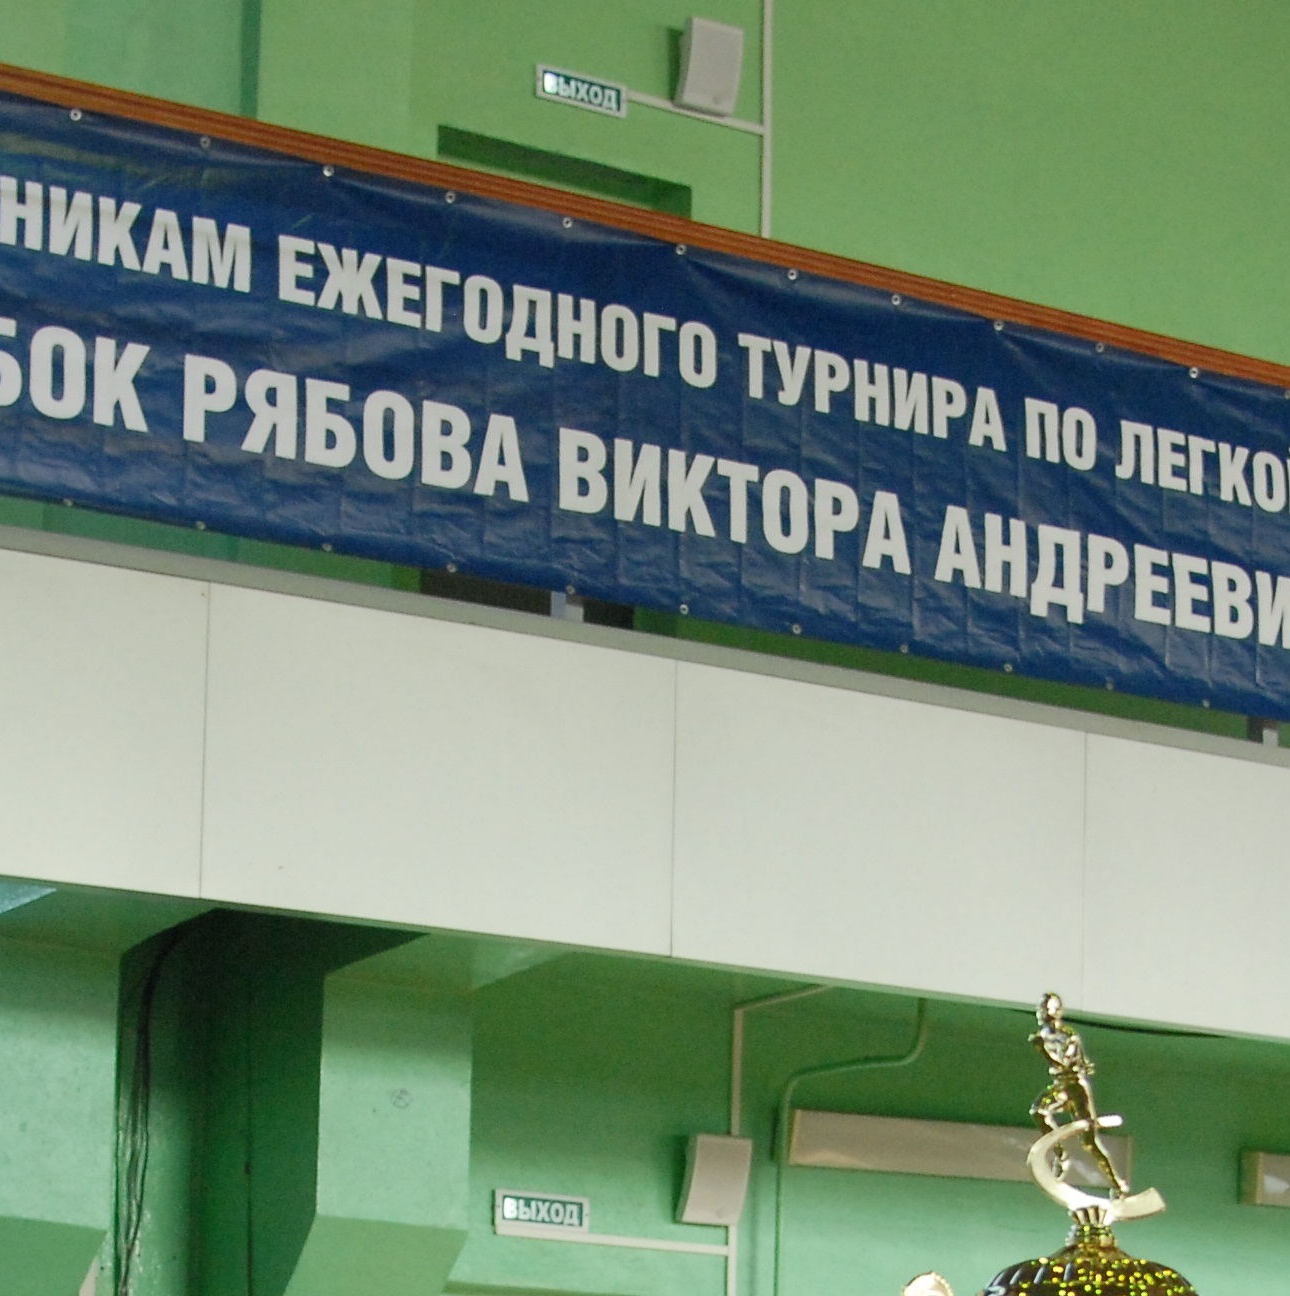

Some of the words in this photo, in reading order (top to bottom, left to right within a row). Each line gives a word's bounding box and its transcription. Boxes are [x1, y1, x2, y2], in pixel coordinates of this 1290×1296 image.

[182, 353, 529, 502] РЯБОВА
[558, 427, 912, 576] ВИКТОРА
[278, 235, 717, 389] ЕЖЕГОДНОГО
[738, 333, 1007, 452] ТУРНИРА
[1024, 397, 1097, 471] ПО
[503, 1197, 579, 1226] ВЫХОД
